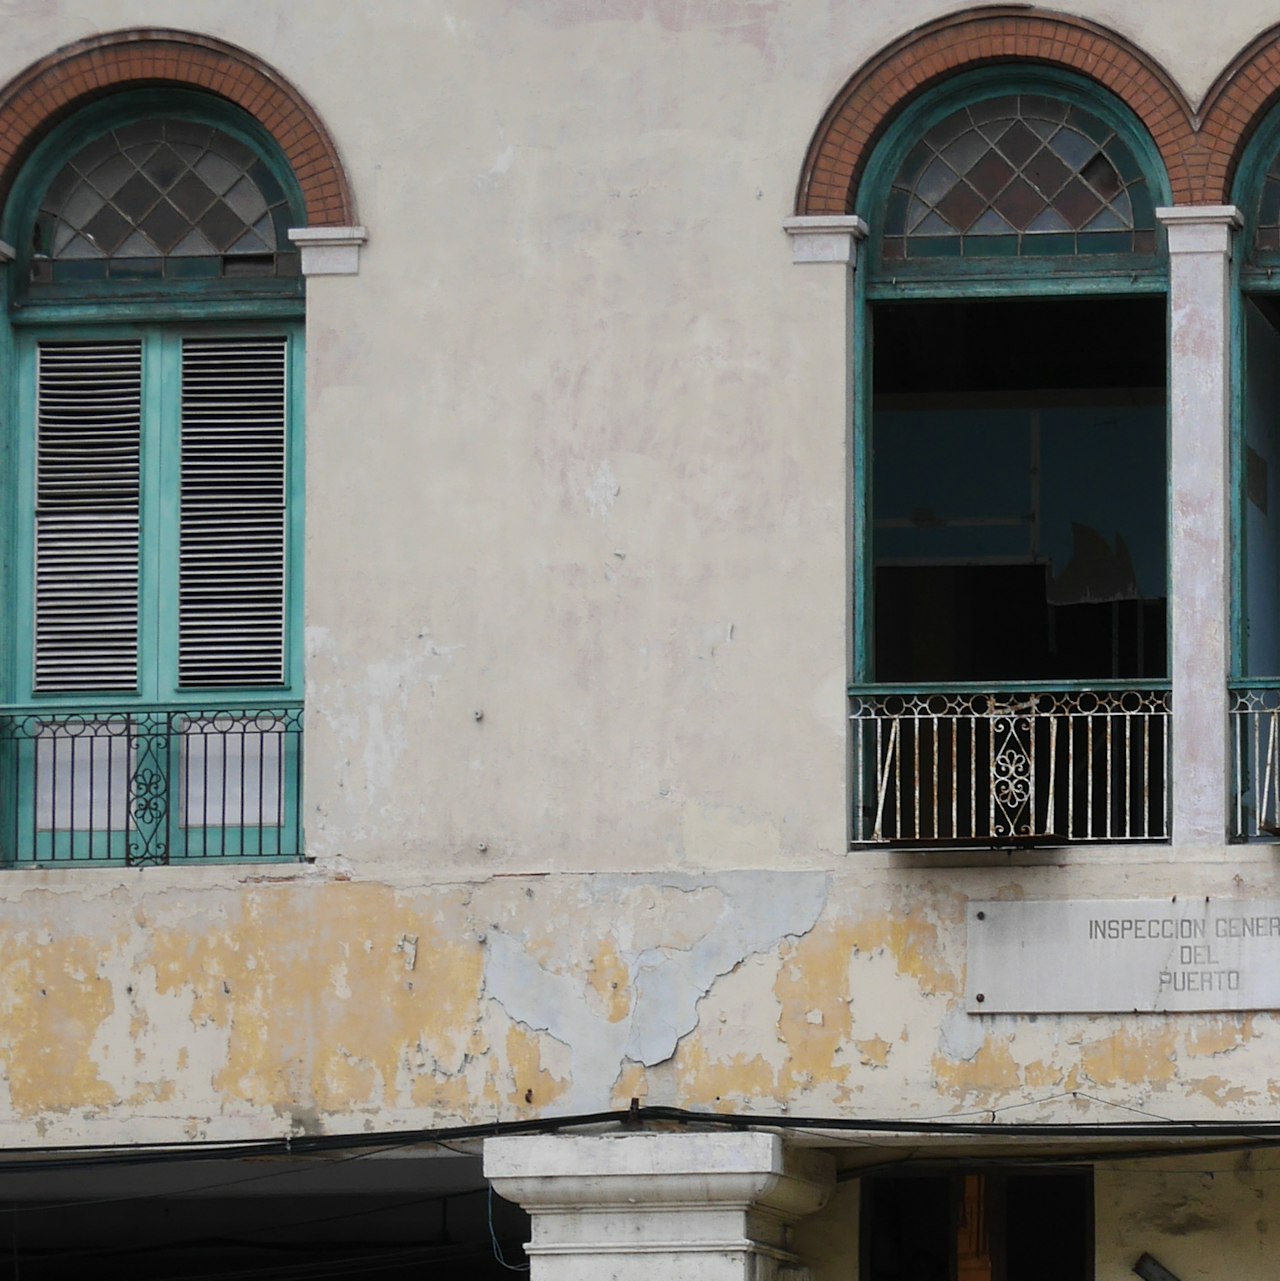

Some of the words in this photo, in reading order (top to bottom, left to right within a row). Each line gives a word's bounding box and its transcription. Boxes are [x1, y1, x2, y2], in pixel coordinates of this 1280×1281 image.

[1089, 918, 1206, 940] INSPECCION
[1180, 945, 1219, 965] DEL
[1159, 970, 1240, 992] PUERTO
